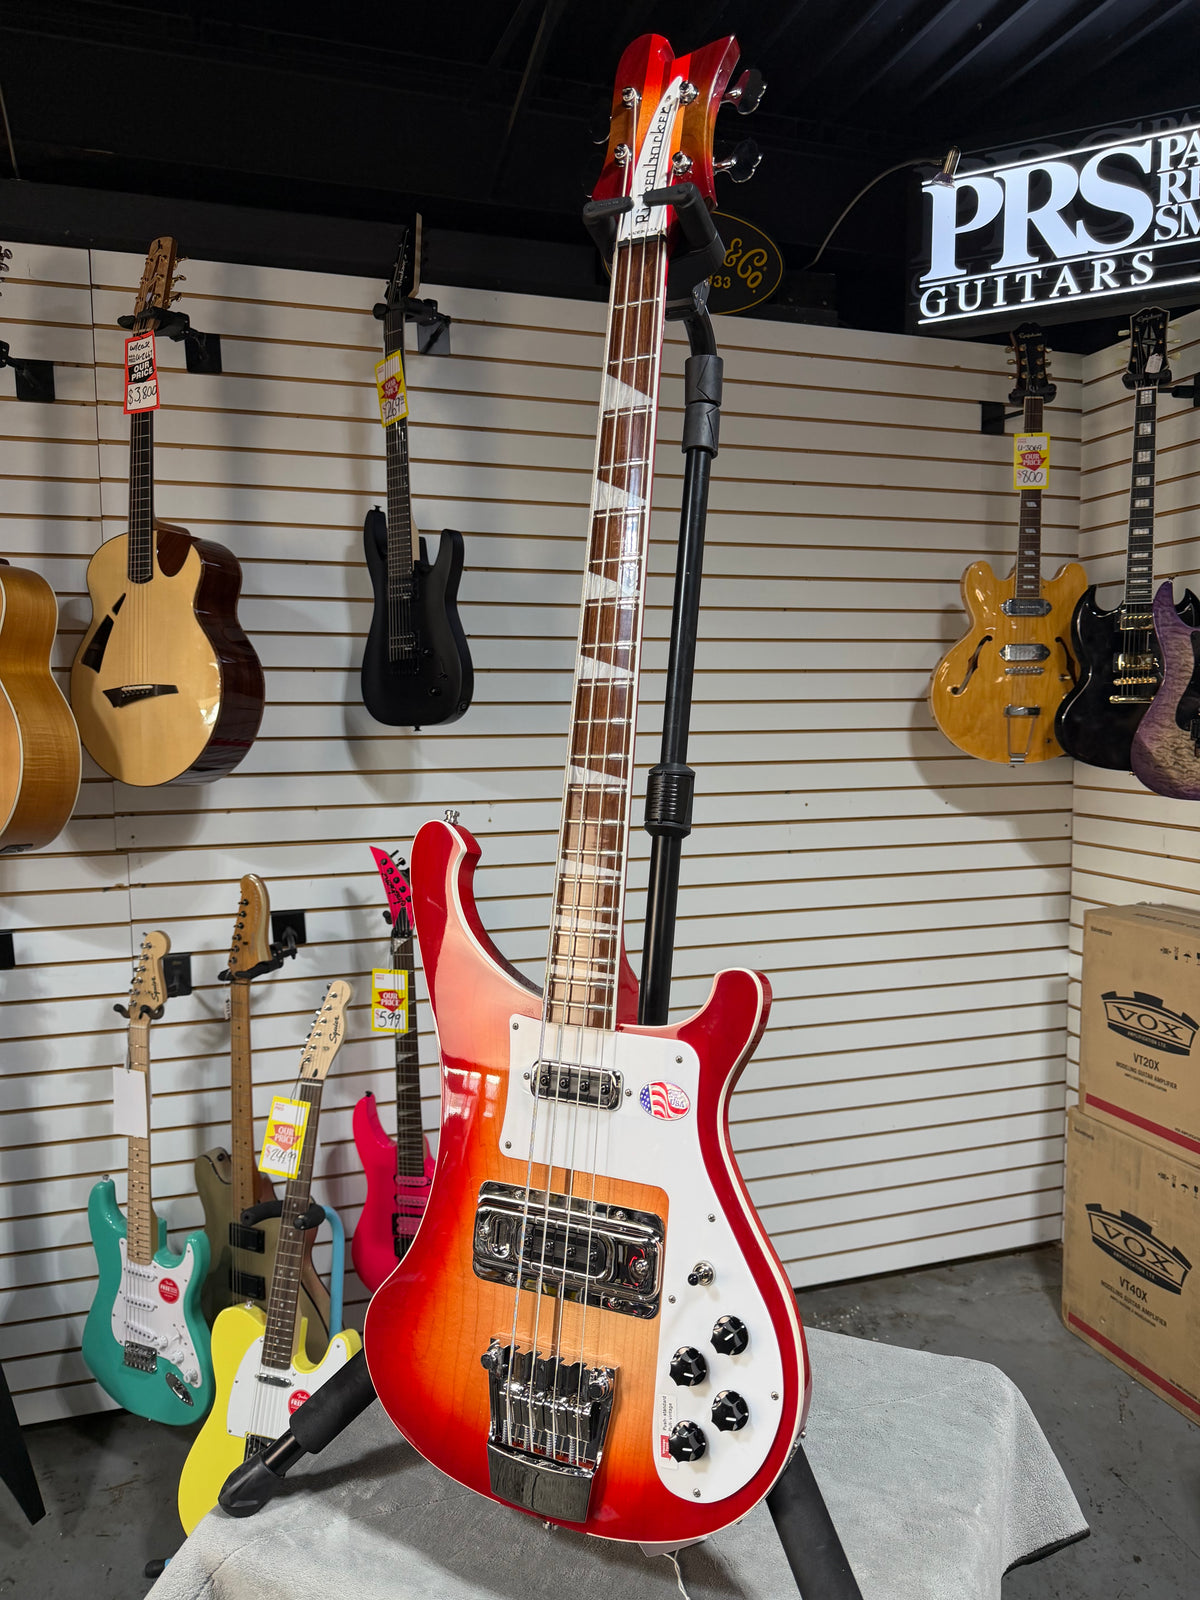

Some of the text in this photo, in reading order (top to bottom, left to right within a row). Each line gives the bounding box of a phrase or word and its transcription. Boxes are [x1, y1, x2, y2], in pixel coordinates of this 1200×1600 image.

[920, 140, 1153, 282] PRS
[920, 251, 1154, 318] GUITARS
[131, 366, 154, 382] PRICE
[133, 361, 150, 373] OUR
[380, 998, 401, 1006] PRICE
[329, 1015, 340, 1045] Squier
[1112, 1004, 1184, 1041] VOX
[1133, 1052, 1160, 1072] VT20X
[274, 1133, 296, 1145] PRICE
[278, 1126, 295, 1137] OUR
[1097, 1218, 1175, 1277] VOX
[1119, 1276, 1148, 1303] VT40X
